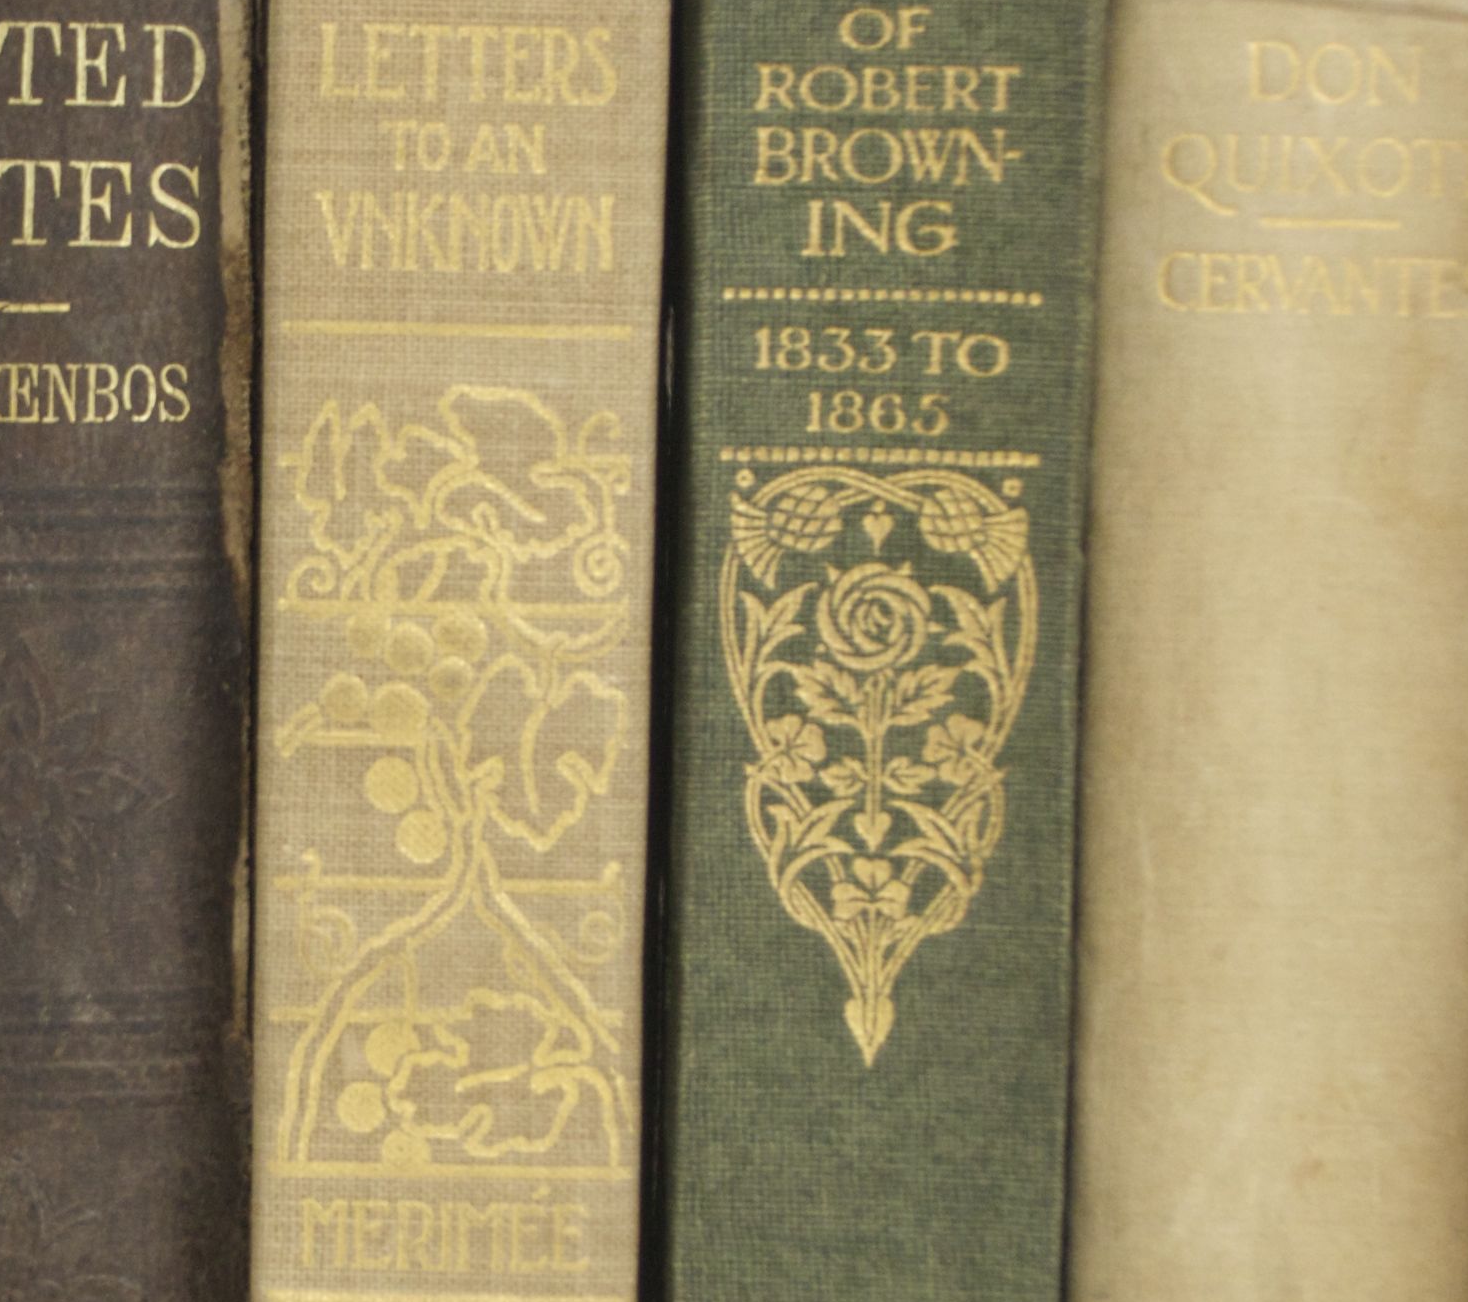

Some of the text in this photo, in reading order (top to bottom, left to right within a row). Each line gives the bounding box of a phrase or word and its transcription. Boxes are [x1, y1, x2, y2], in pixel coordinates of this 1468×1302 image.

[838, 7, 931, 51] OF
[319, 22, 619, 107] LETTERS
[754, 64, 1022, 113] ROBERT
[1248, 40, 1423, 106] DON
[381, 119, 547, 175] TO AN
[754, 127, 1023, 186] BROWN-
[801, 199, 958, 257] ING
[754, 325, 1010, 377] 1833 TO
[807, 389, 950, 436] 1865
